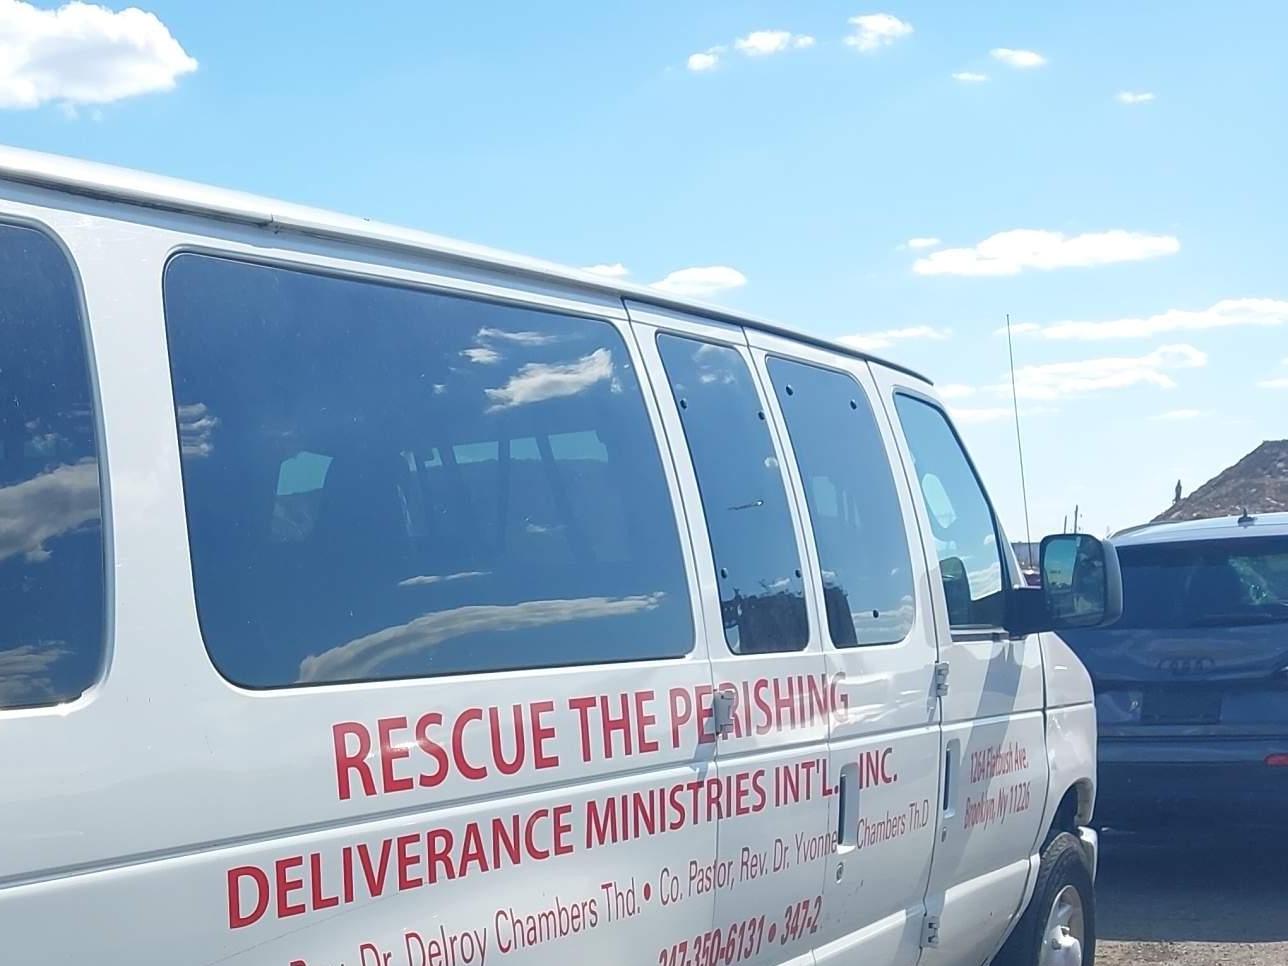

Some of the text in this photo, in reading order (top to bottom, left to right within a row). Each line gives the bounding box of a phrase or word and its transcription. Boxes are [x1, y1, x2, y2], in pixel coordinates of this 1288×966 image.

[333, 671, 849, 801] RESCUE THE PERISHING
[986, 742, 1013, 779] Flatbush
[1014, 741, 1029, 772] Ave.
[227, 747, 898, 929] DELIVERANCE MINISTRIES INT'L. INC.
[1009, 780, 1032, 814] 11226
[494, 896, 598, 954] Chambers
[659, 868, 684, 906] Co.
[687, 858, 735, 899] Pastor,
[739, 846, 769, 883] Rev.
[772, 837, 790, 873] Dr.
[794, 829, 839, 865] Yvonne
[856, 810, 907, 850] Chambers
[909, 799, 930, 832] Th.D
[780, 895, 823, 946] 347-2
